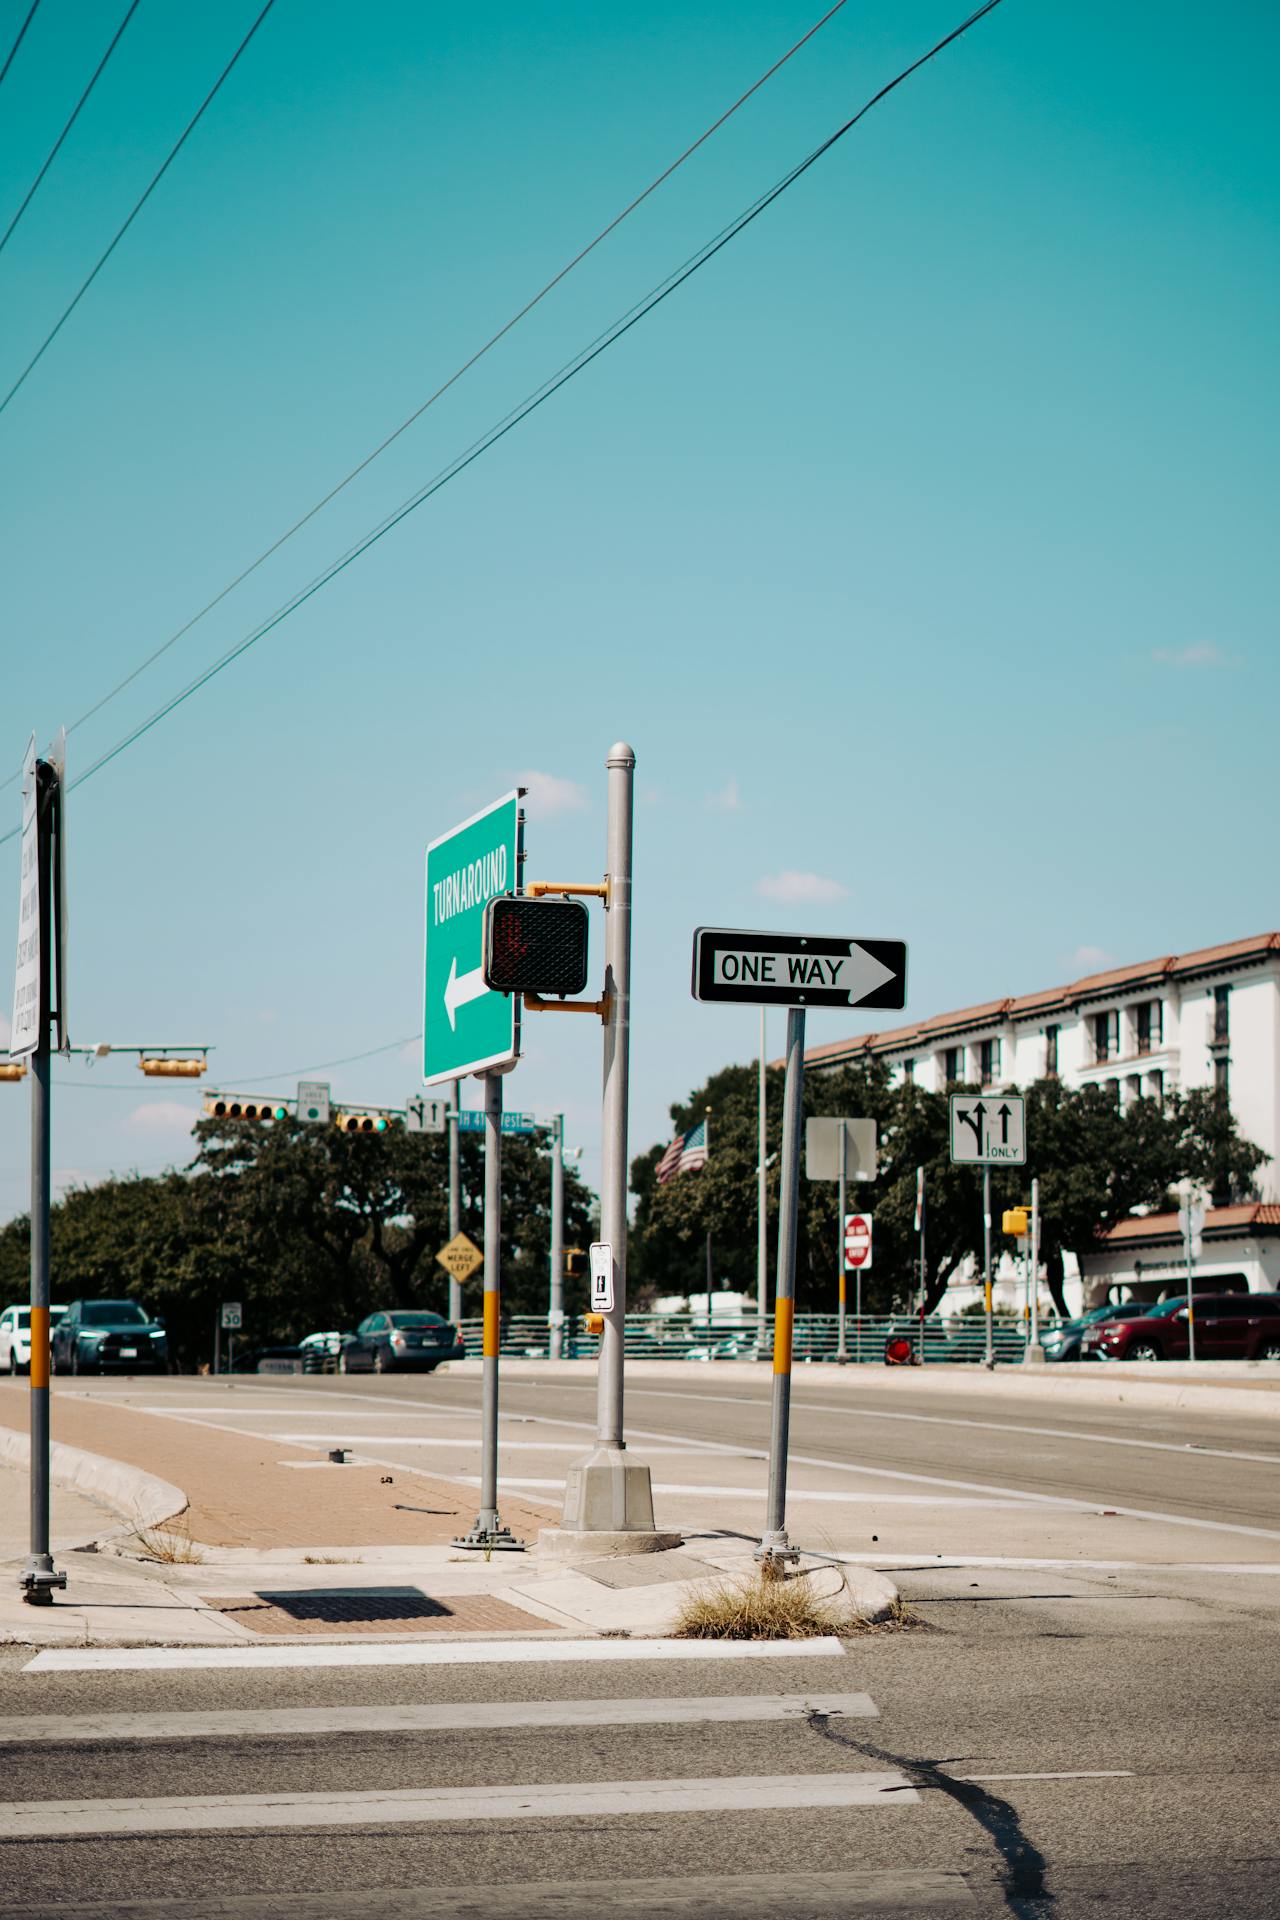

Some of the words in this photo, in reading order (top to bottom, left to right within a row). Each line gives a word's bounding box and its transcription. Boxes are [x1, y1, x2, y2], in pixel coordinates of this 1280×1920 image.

[433, 844, 507, 926] TURNAROUND
[721, 954, 776, 983] ONE
[787, 957, 844, 985] WAY
[991, 1147, 1018, 1158] ONLY
[447, 1254, 473, 1262] MERGE
[451, 1263, 470, 1272] LEFT
[224, 1313, 240, 1325] 30
